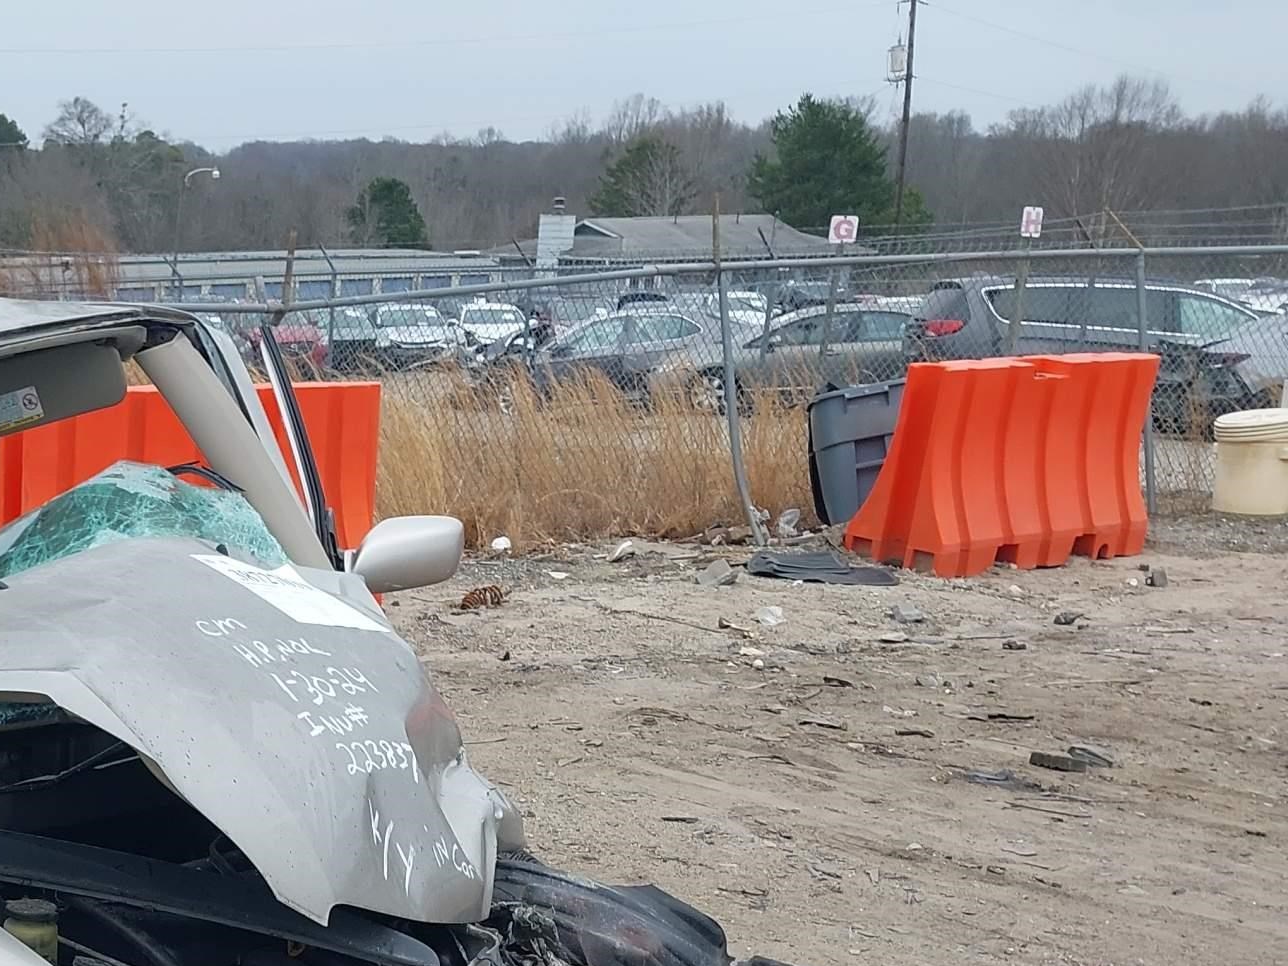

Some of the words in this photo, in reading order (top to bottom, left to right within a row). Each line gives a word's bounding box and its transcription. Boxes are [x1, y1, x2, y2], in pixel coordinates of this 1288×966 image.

[833, 219, 855, 240] G
[1024, 211, 1041, 233] H
[270, 666, 379, 706] 1-30-24
